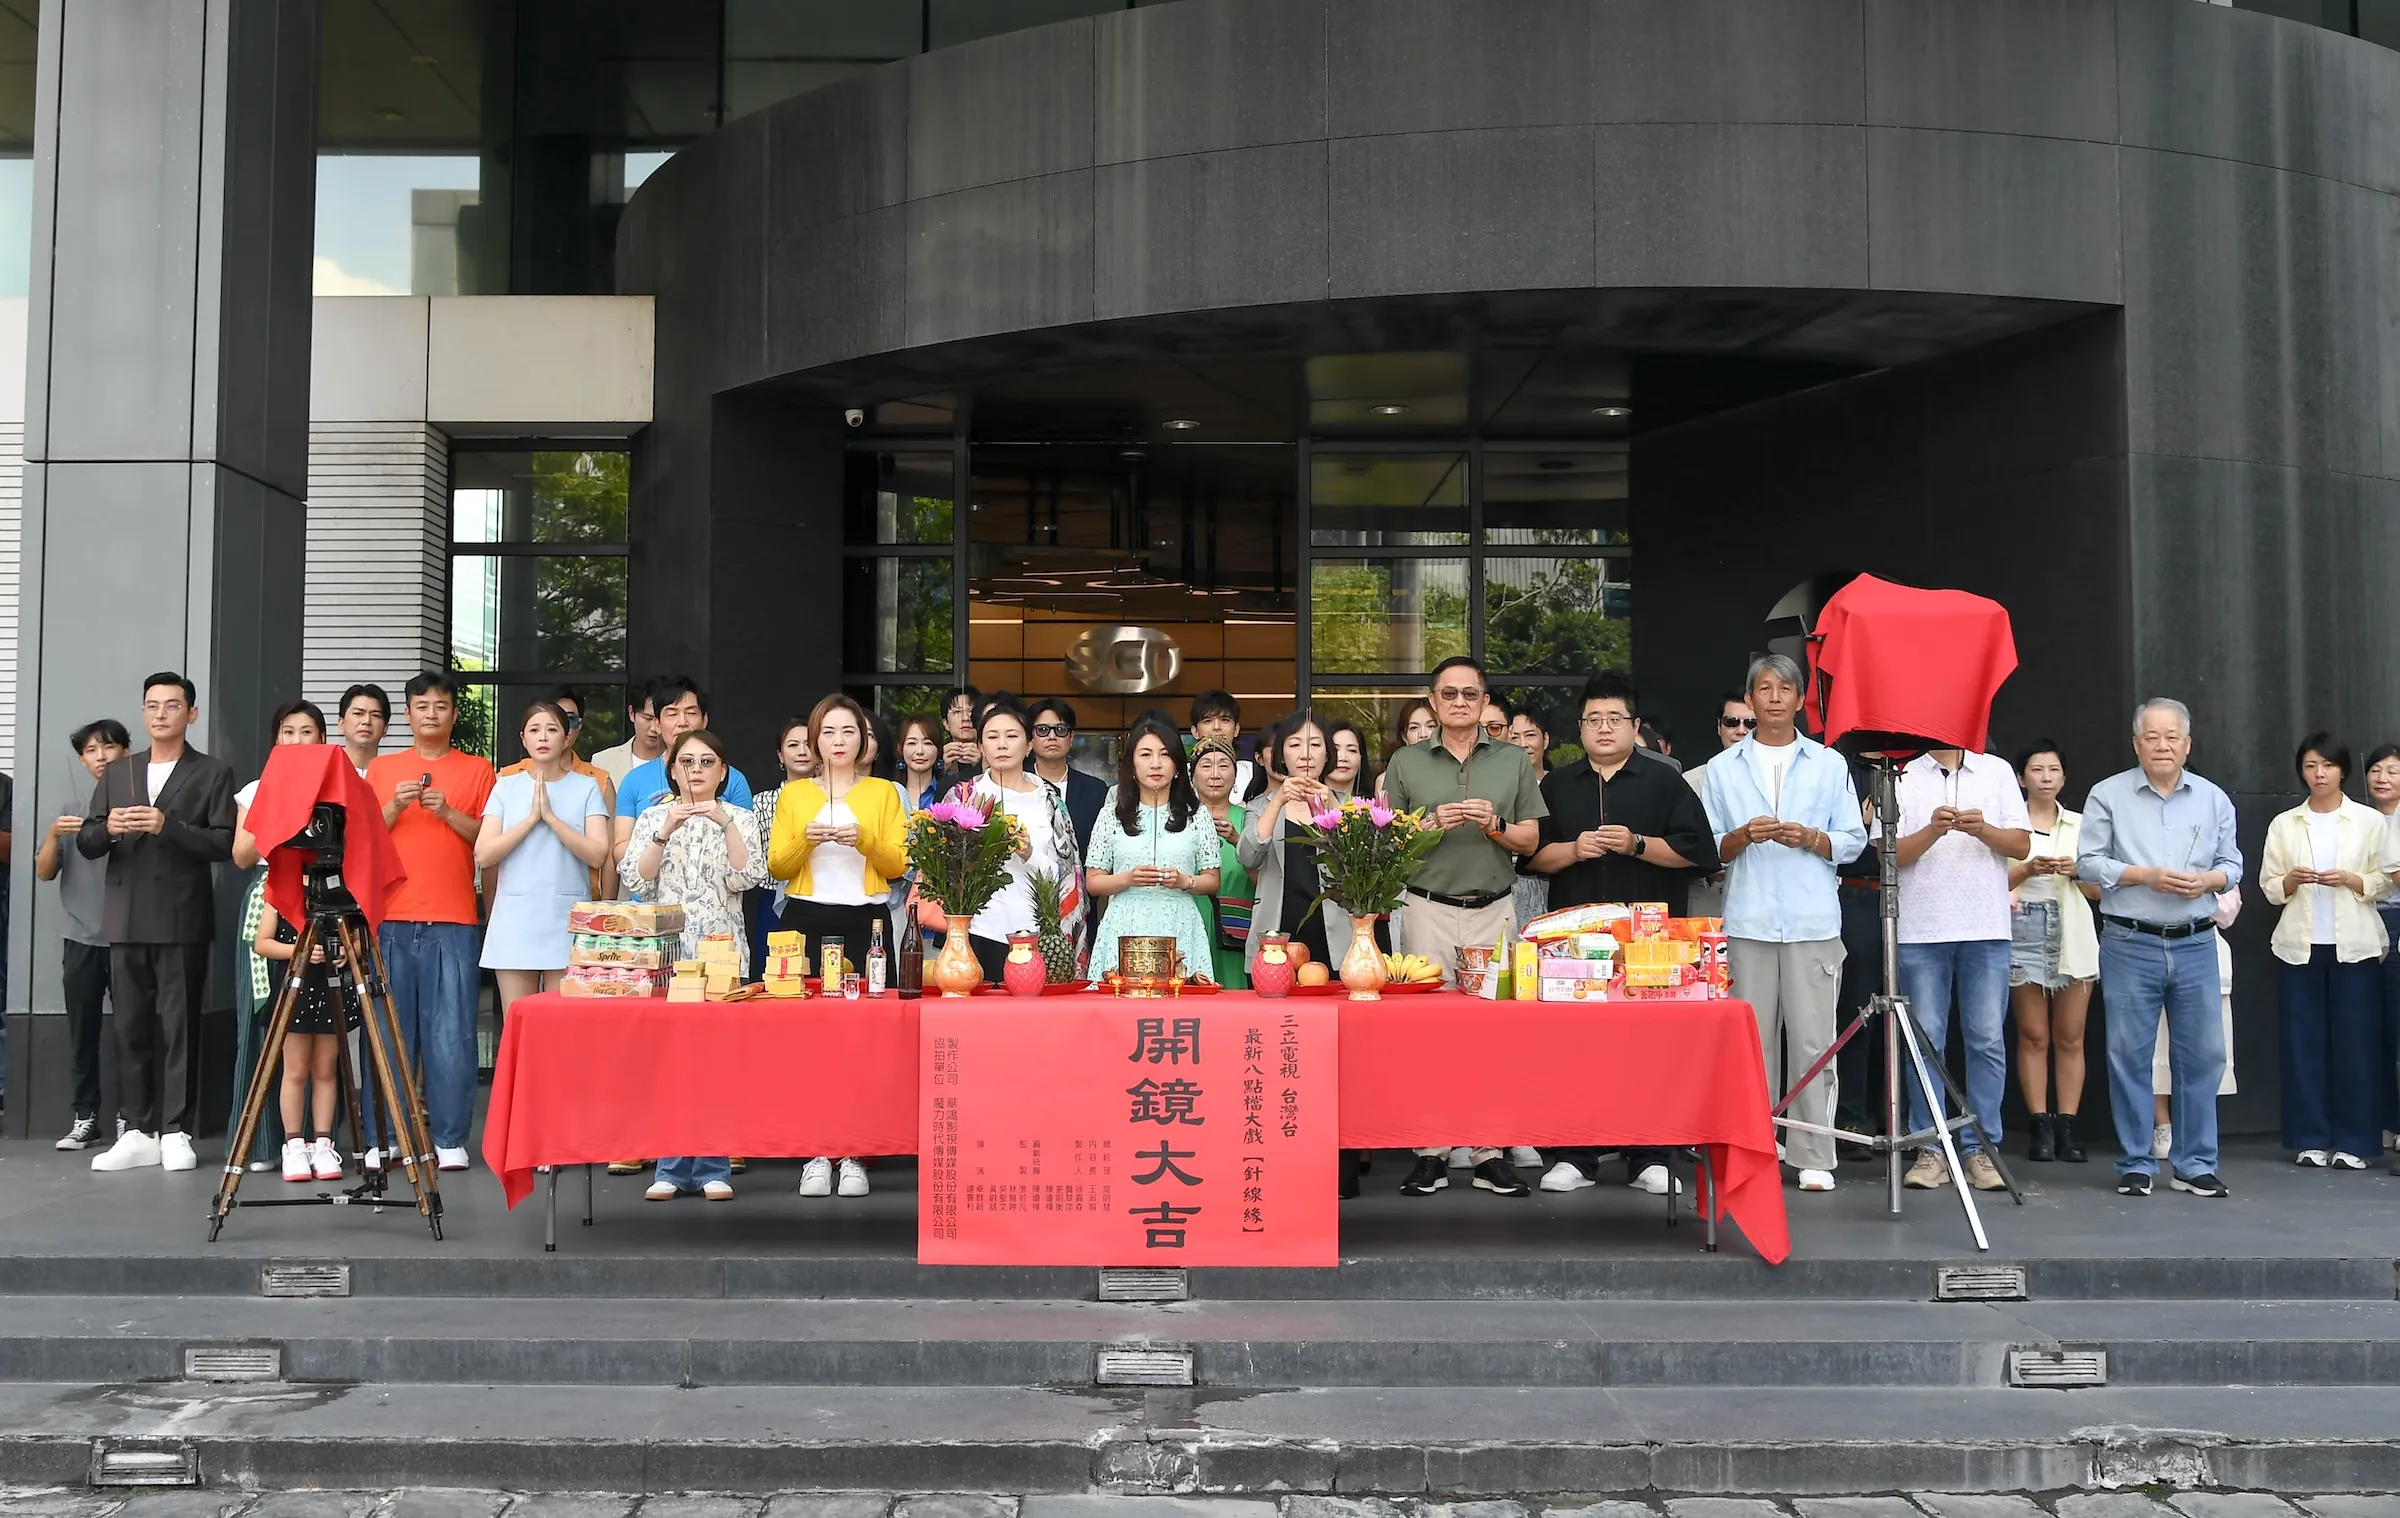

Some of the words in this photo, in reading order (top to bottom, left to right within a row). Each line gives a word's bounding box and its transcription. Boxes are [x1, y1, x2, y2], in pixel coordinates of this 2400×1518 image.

[597, 952, 622, 962] Sprite
[933, 1038, 945, 1084] 協拍單位
[947, 1038, 958, 1084] 製作公司
[1280, 1015, 1300, 1079] 三立電視
[1243, 1028, 1264, 1144] 最新八點檔大戲
[1280, 1088, 1299, 1138] 台灣台
[1127, 1017, 1206, 1249] 開鏡大吉
[1242, 1157, 1264, 1232] 【針線緣】
